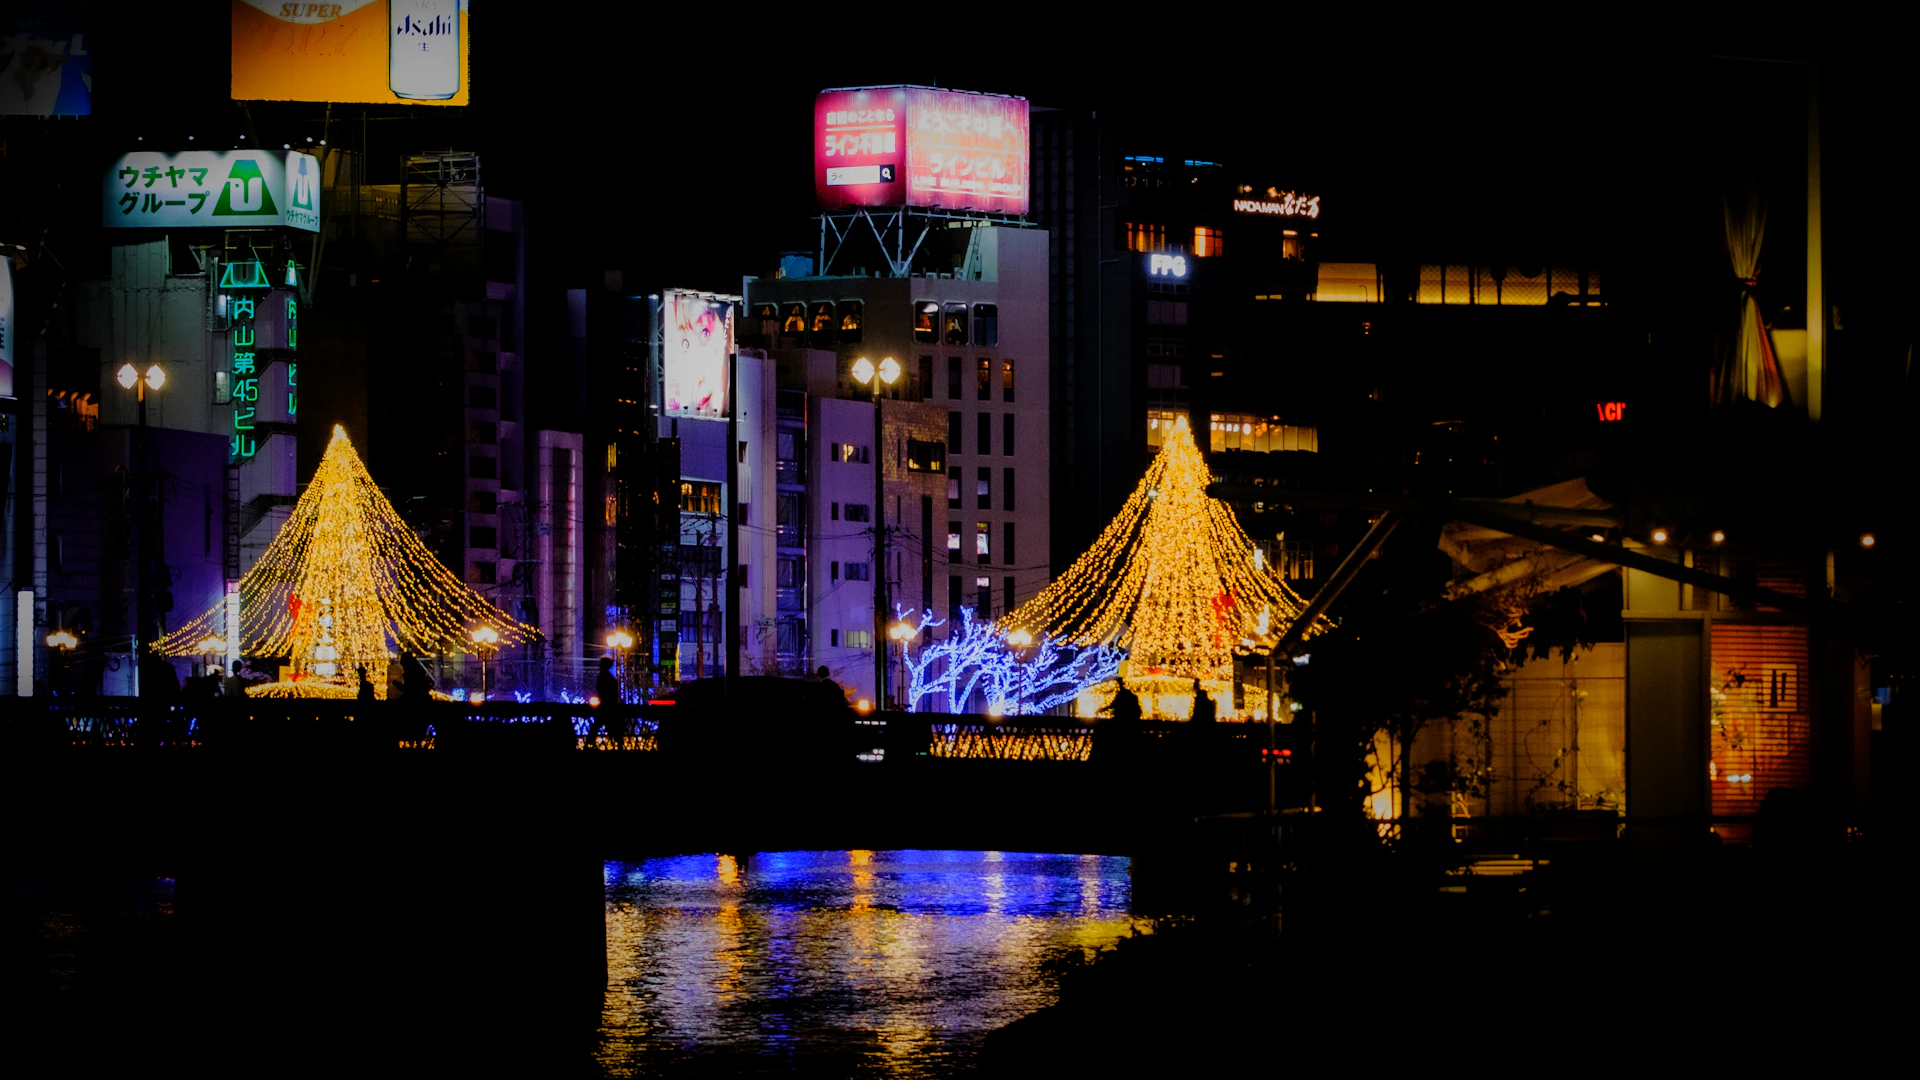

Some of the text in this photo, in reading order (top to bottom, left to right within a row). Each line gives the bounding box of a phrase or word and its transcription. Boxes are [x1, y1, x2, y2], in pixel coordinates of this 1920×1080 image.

[279, 3, 342, 18] SUPER
[397, 14, 452, 36] Asahi
[918, 109, 1018, 139] ようこそ中へ
[825, 131, 896, 156] ライン不
[930, 151, 1007, 179] ラインビル
[119, 166, 208, 188] ウチヤマ
[119, 191, 210, 215] グループ
[1234, 200, 1284, 215] NADAMAN
[286, 209, 319, 226] ウチヤマグループ
[1151, 254, 1185, 276] FPG
[232, 295, 259, 457] 内山第45ビル
